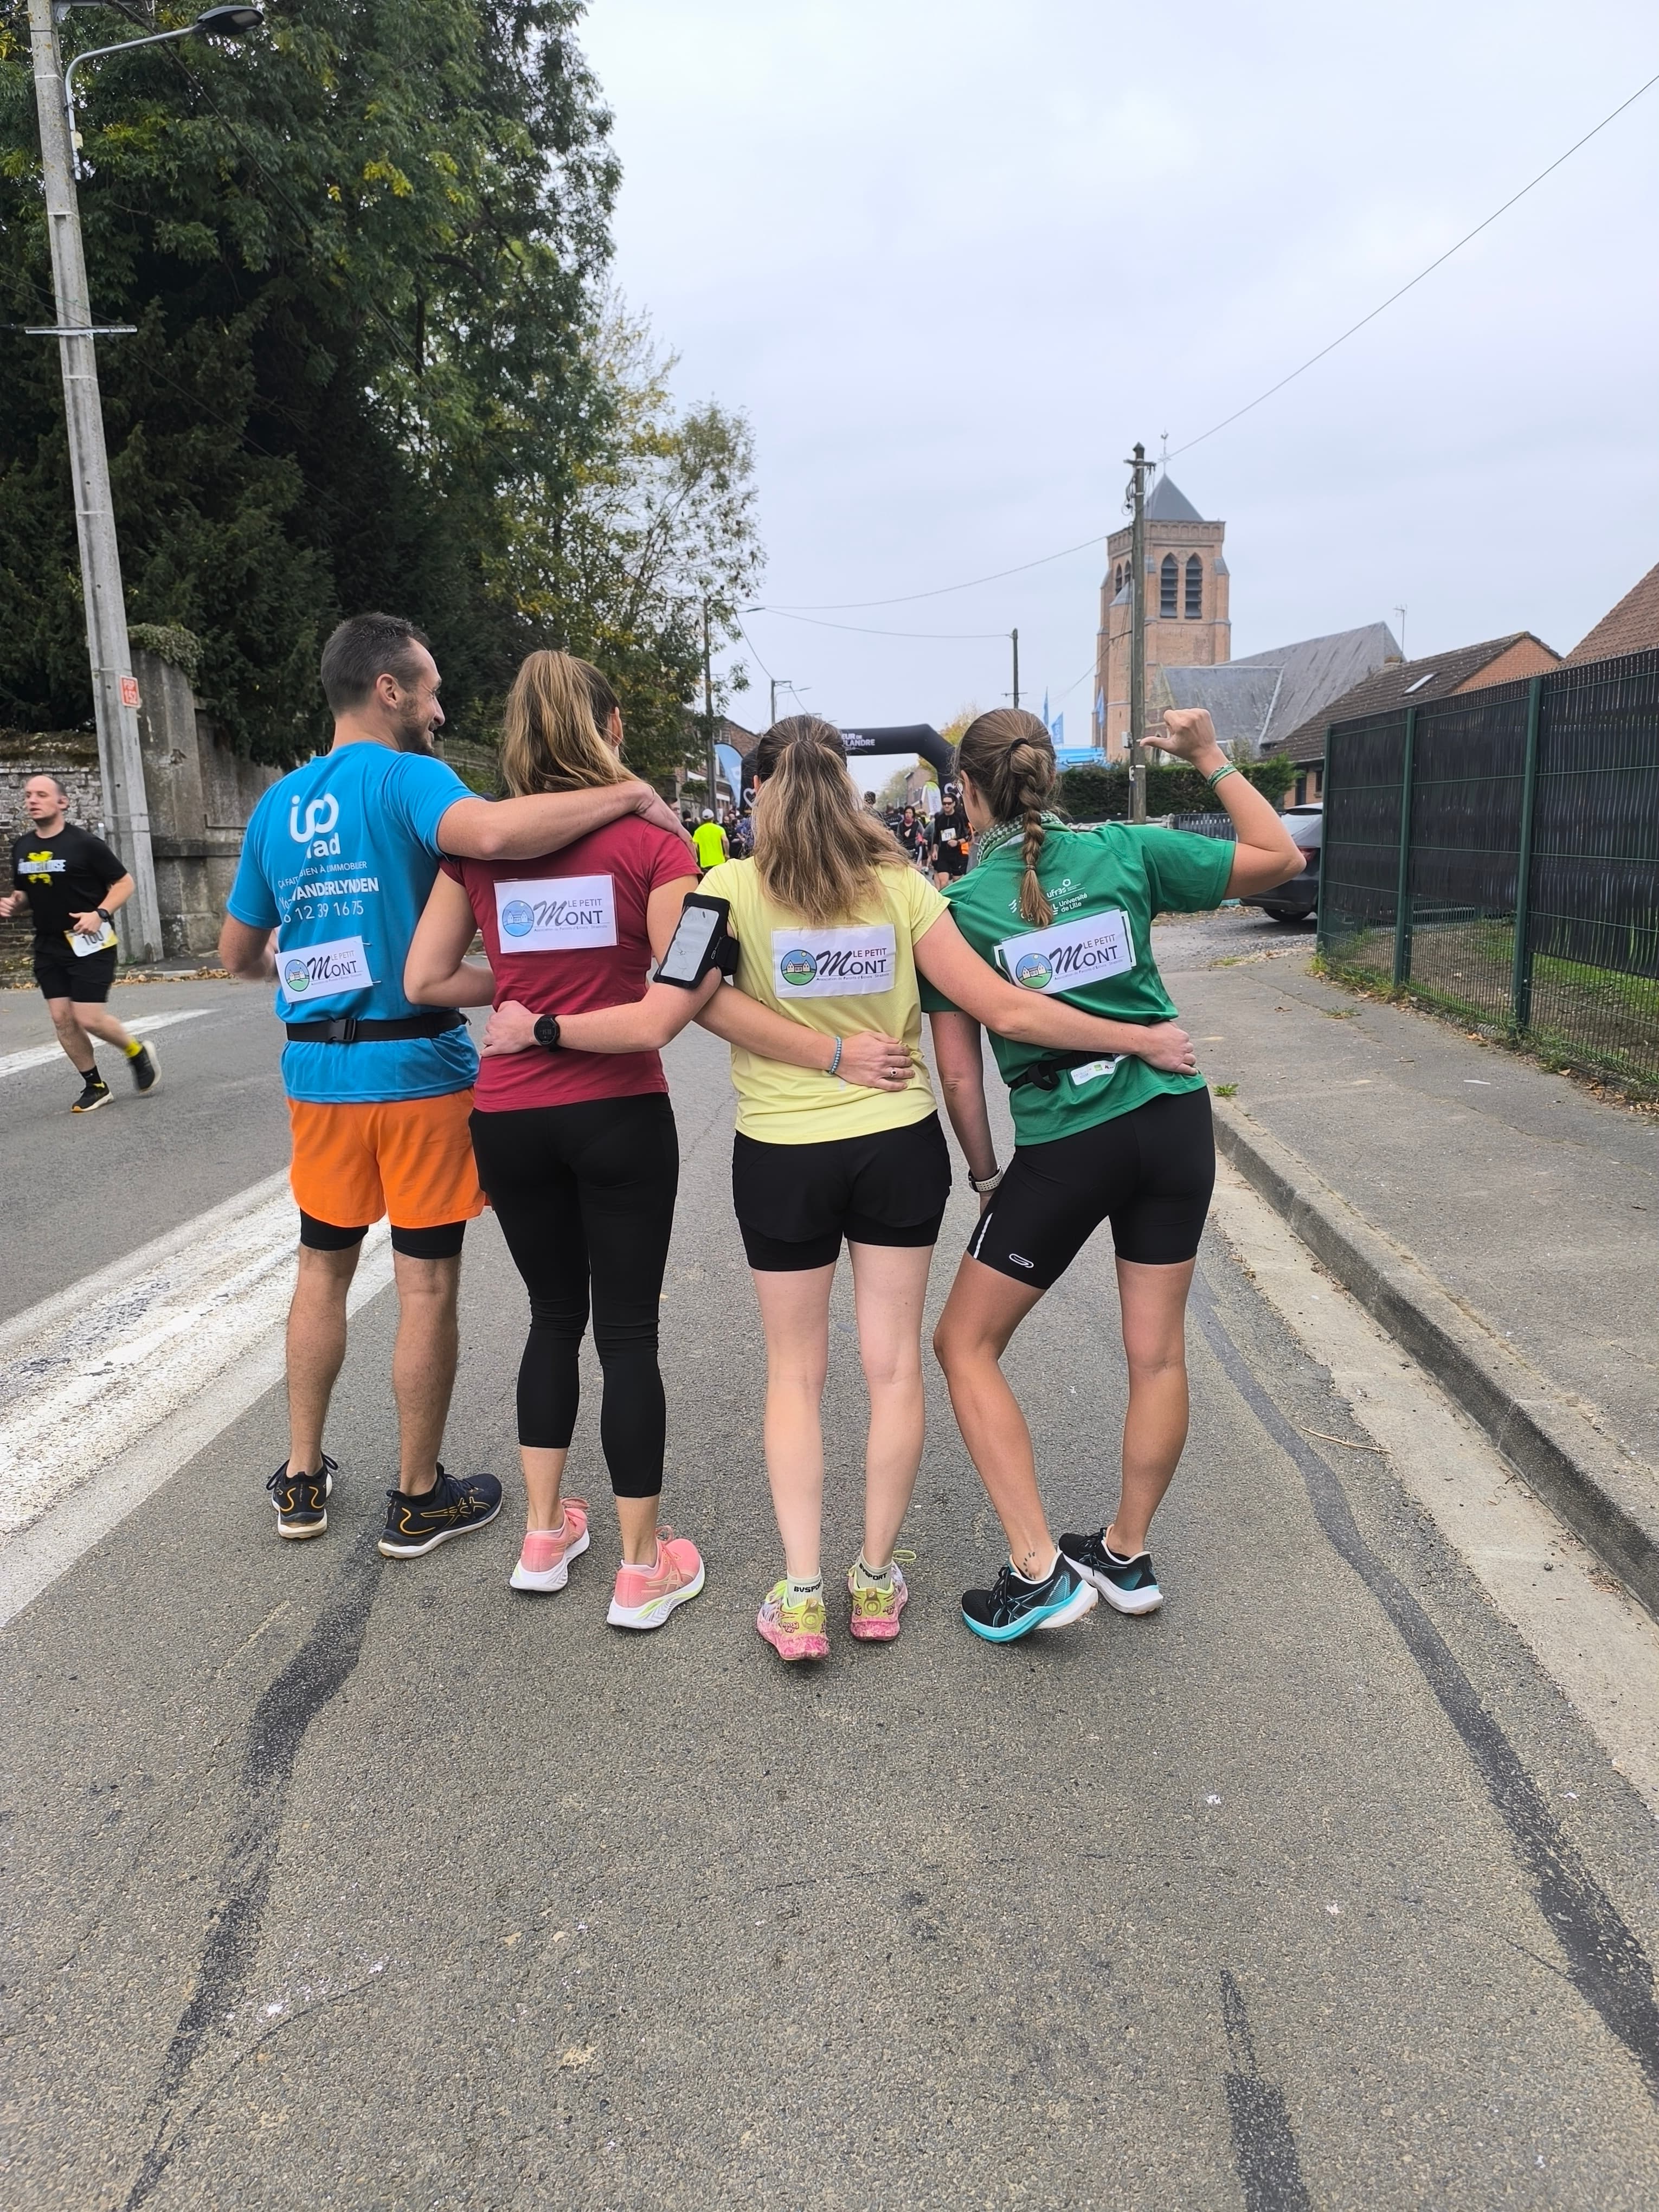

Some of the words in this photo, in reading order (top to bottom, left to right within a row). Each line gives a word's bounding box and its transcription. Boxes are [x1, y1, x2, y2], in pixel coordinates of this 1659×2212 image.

[1059, 892, 1088, 906] Université
[1070, 902, 1082, 910] Lille
[295, 905, 315, 920] 12
[317, 902, 329, 917] 39
[351, 900, 364, 915] 75
[533, 901, 603, 927] MONT
[1083, 941, 1093, 949] LE
[1095, 934, 1116, 946] PETIT
[339, 950, 355, 959] PETIT
[865, 948, 887, 957] PETIT
[1049, 943, 1117, 974] MONT
[307, 955, 357, 980] MONT
[816, 950, 886, 976] MONT
